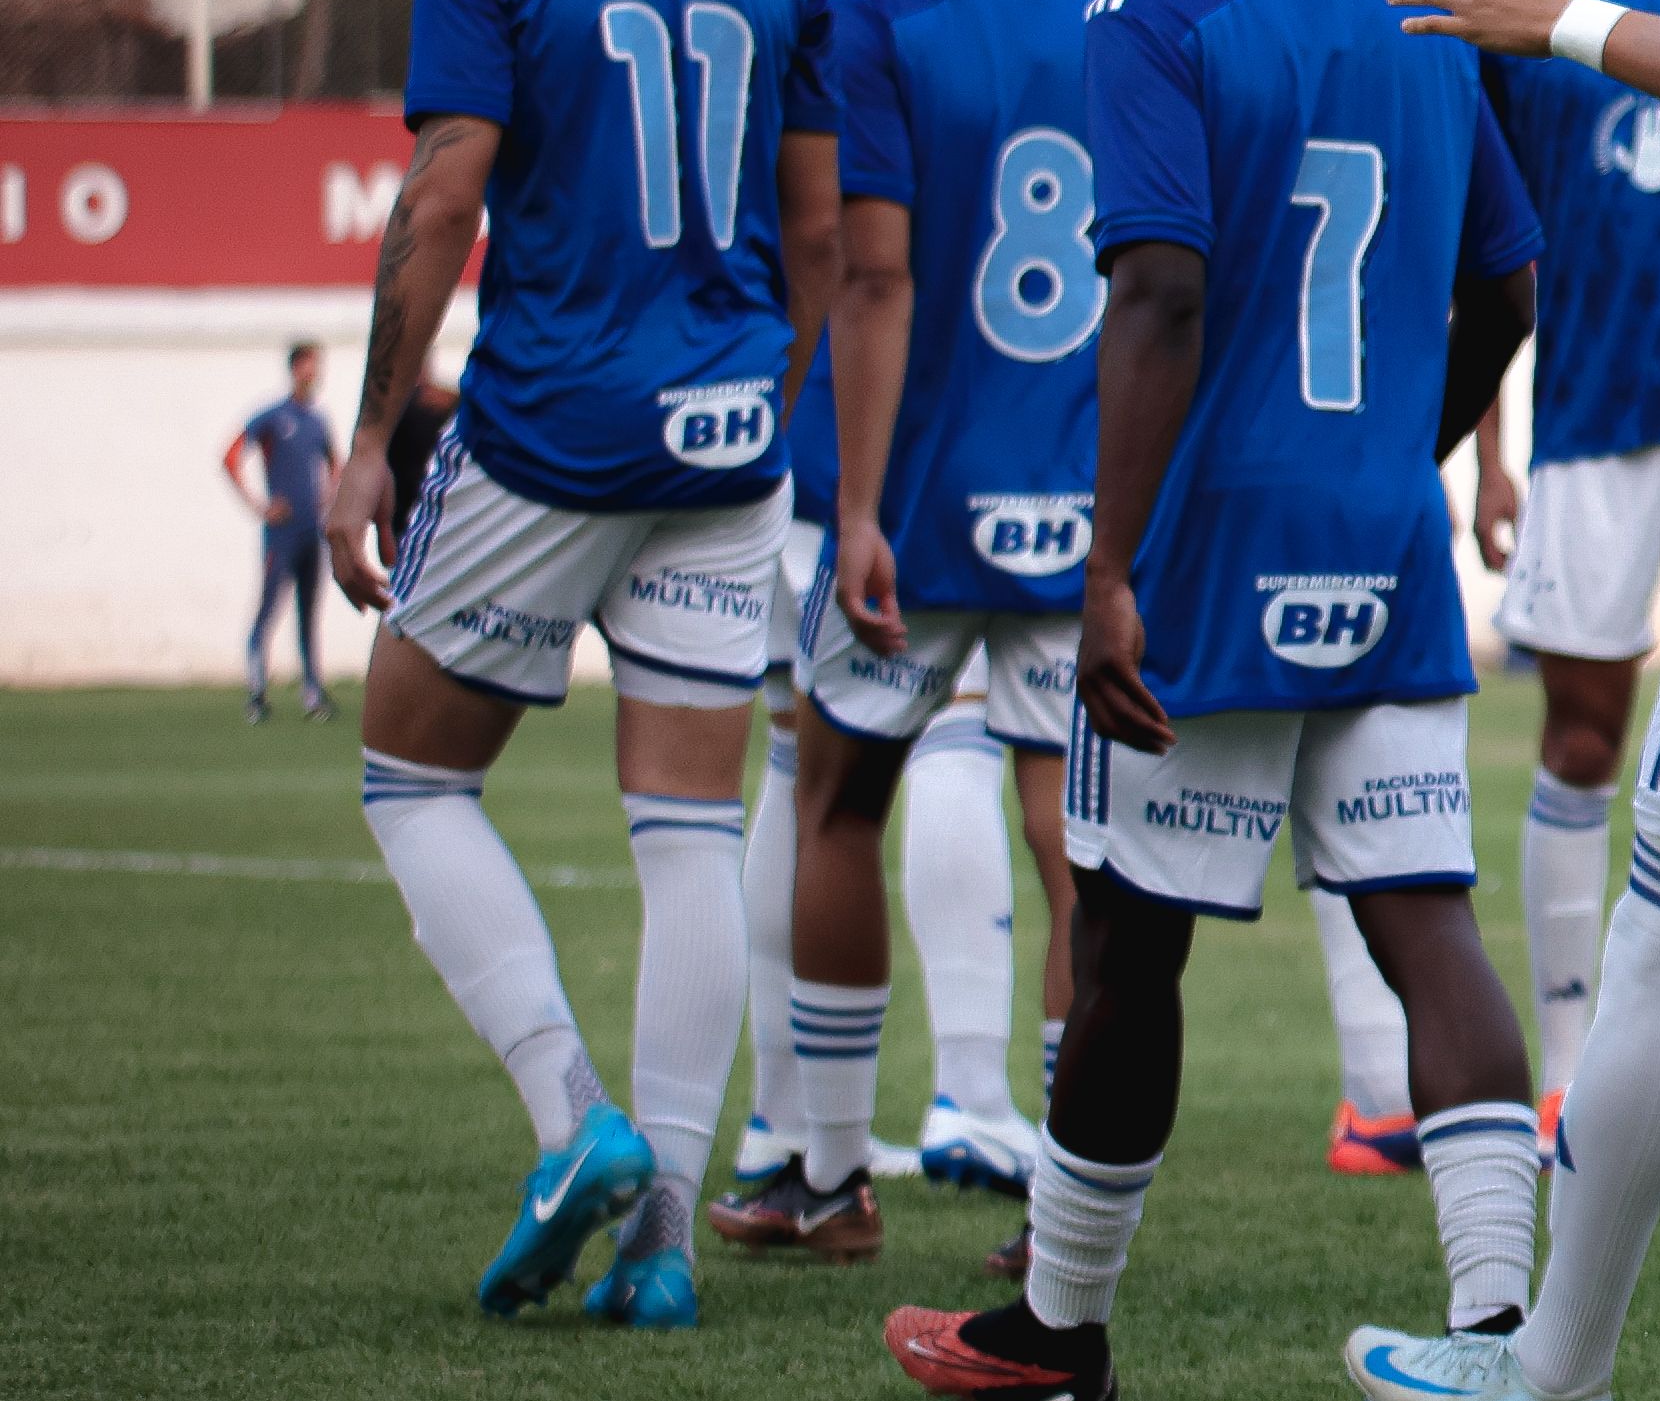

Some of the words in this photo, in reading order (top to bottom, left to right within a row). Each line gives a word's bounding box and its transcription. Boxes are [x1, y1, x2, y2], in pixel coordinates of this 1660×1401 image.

[974, 127, 1107, 363] 8
[1290, 139, 1388, 414] 7
[682, 406, 762, 453] BH
[992, 519, 1075, 555] BH
[1278, 603, 1375, 646] BH
